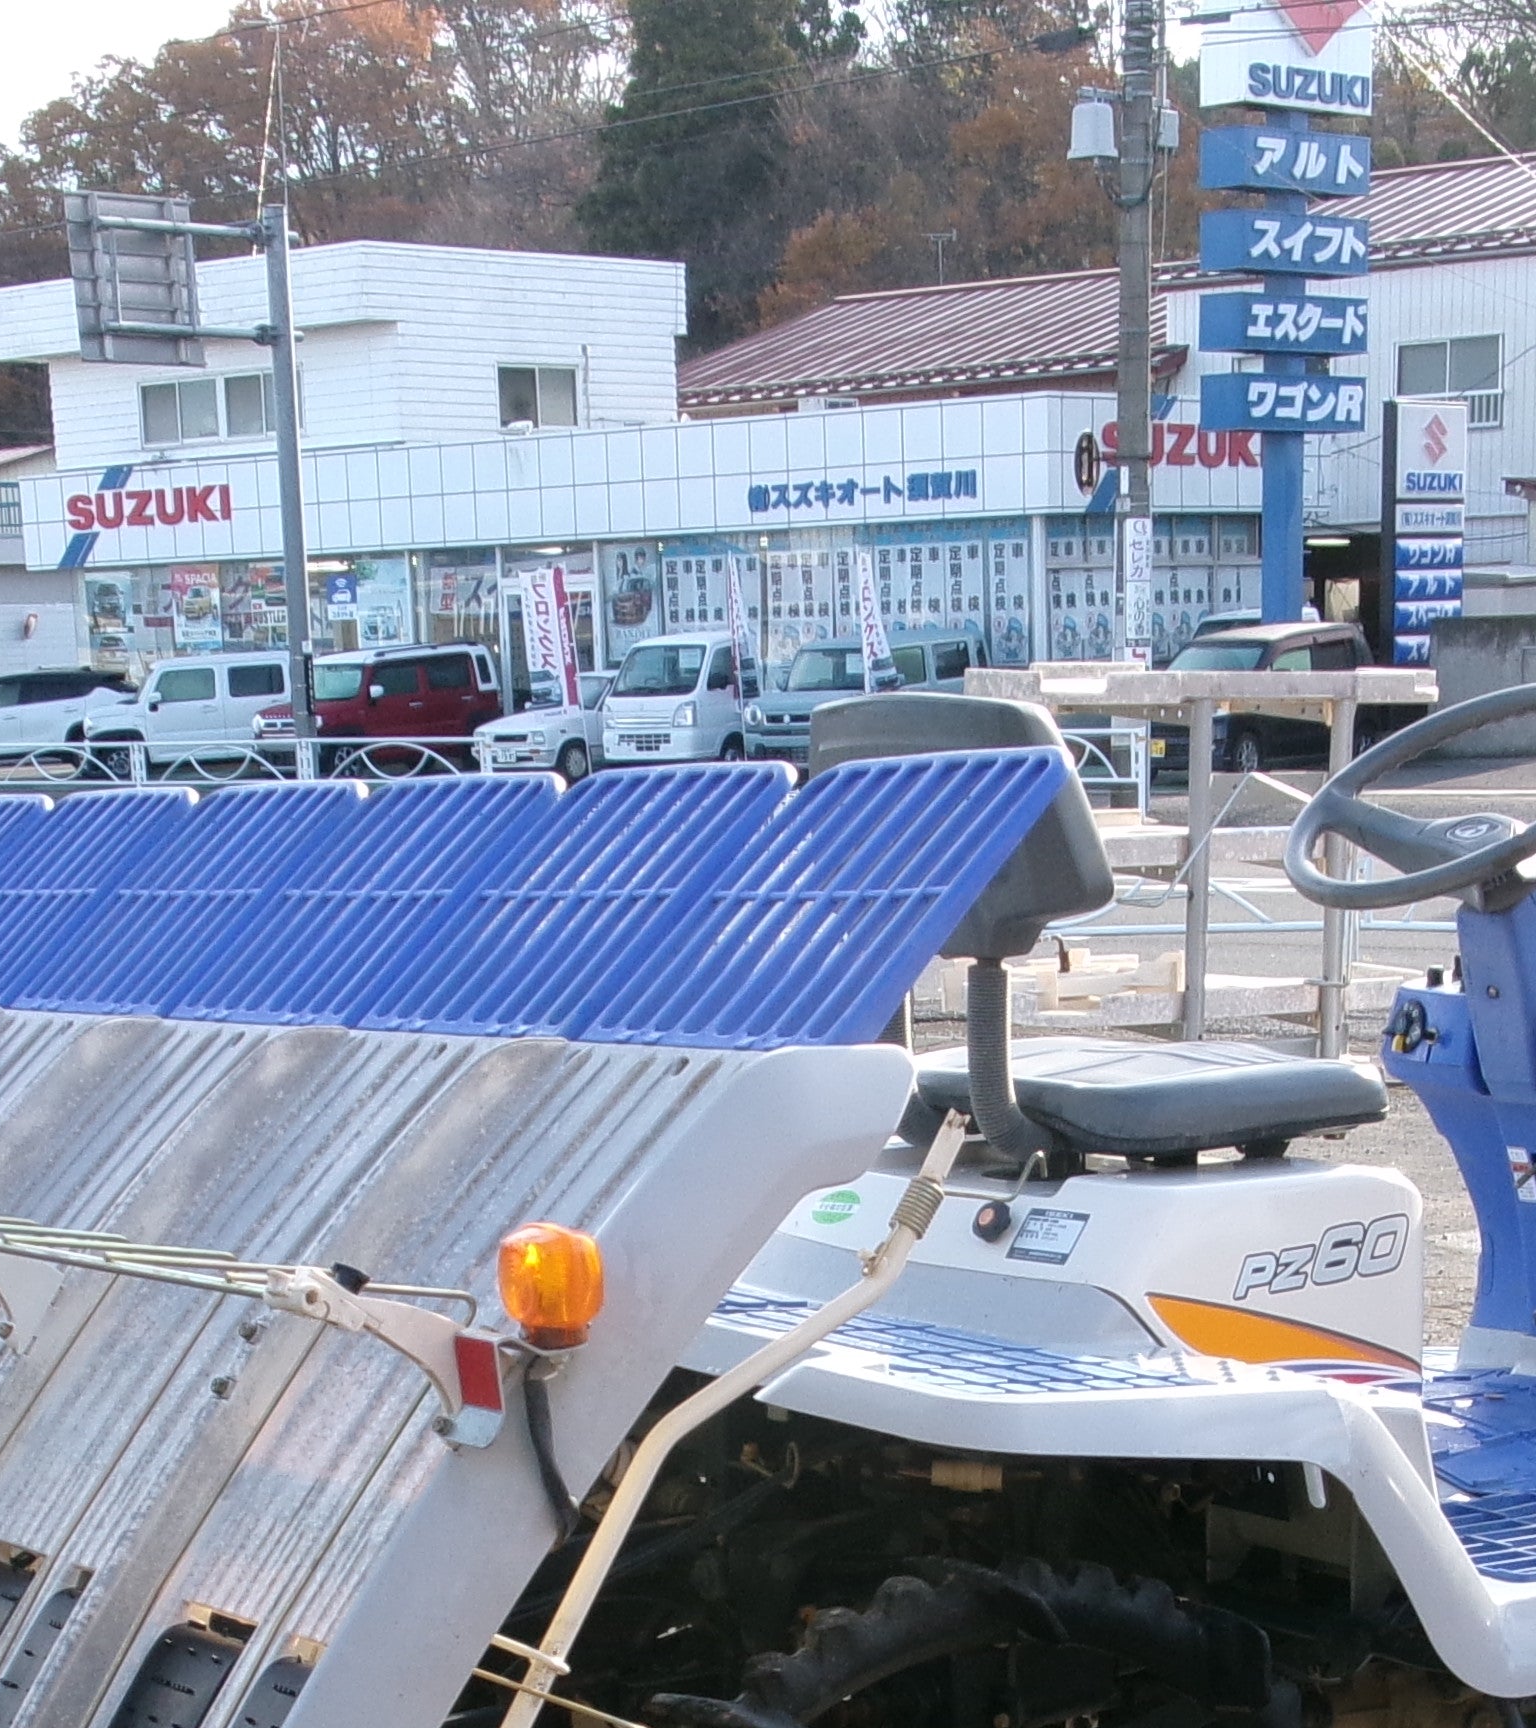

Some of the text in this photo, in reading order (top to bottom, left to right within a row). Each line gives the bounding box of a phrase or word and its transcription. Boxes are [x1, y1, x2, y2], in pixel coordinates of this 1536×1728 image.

[1248, 62, 1370, 108] SUZUKI
[1253, 136, 1365, 185] アルト
[1250, 219, 1366, 265] スイフト
[1247, 303, 1367, 343] エスクード
[1247, 382, 1364, 423] ワゴンR
[1101, 421, 1259, 468] SZUK
[1405, 472, 1463, 492] SUZUKI
[67, 484, 232, 531] SUZUKI
[1408, 574, 1456, 596] アルト
[1233, 1213, 1410, 1301] PZ60
